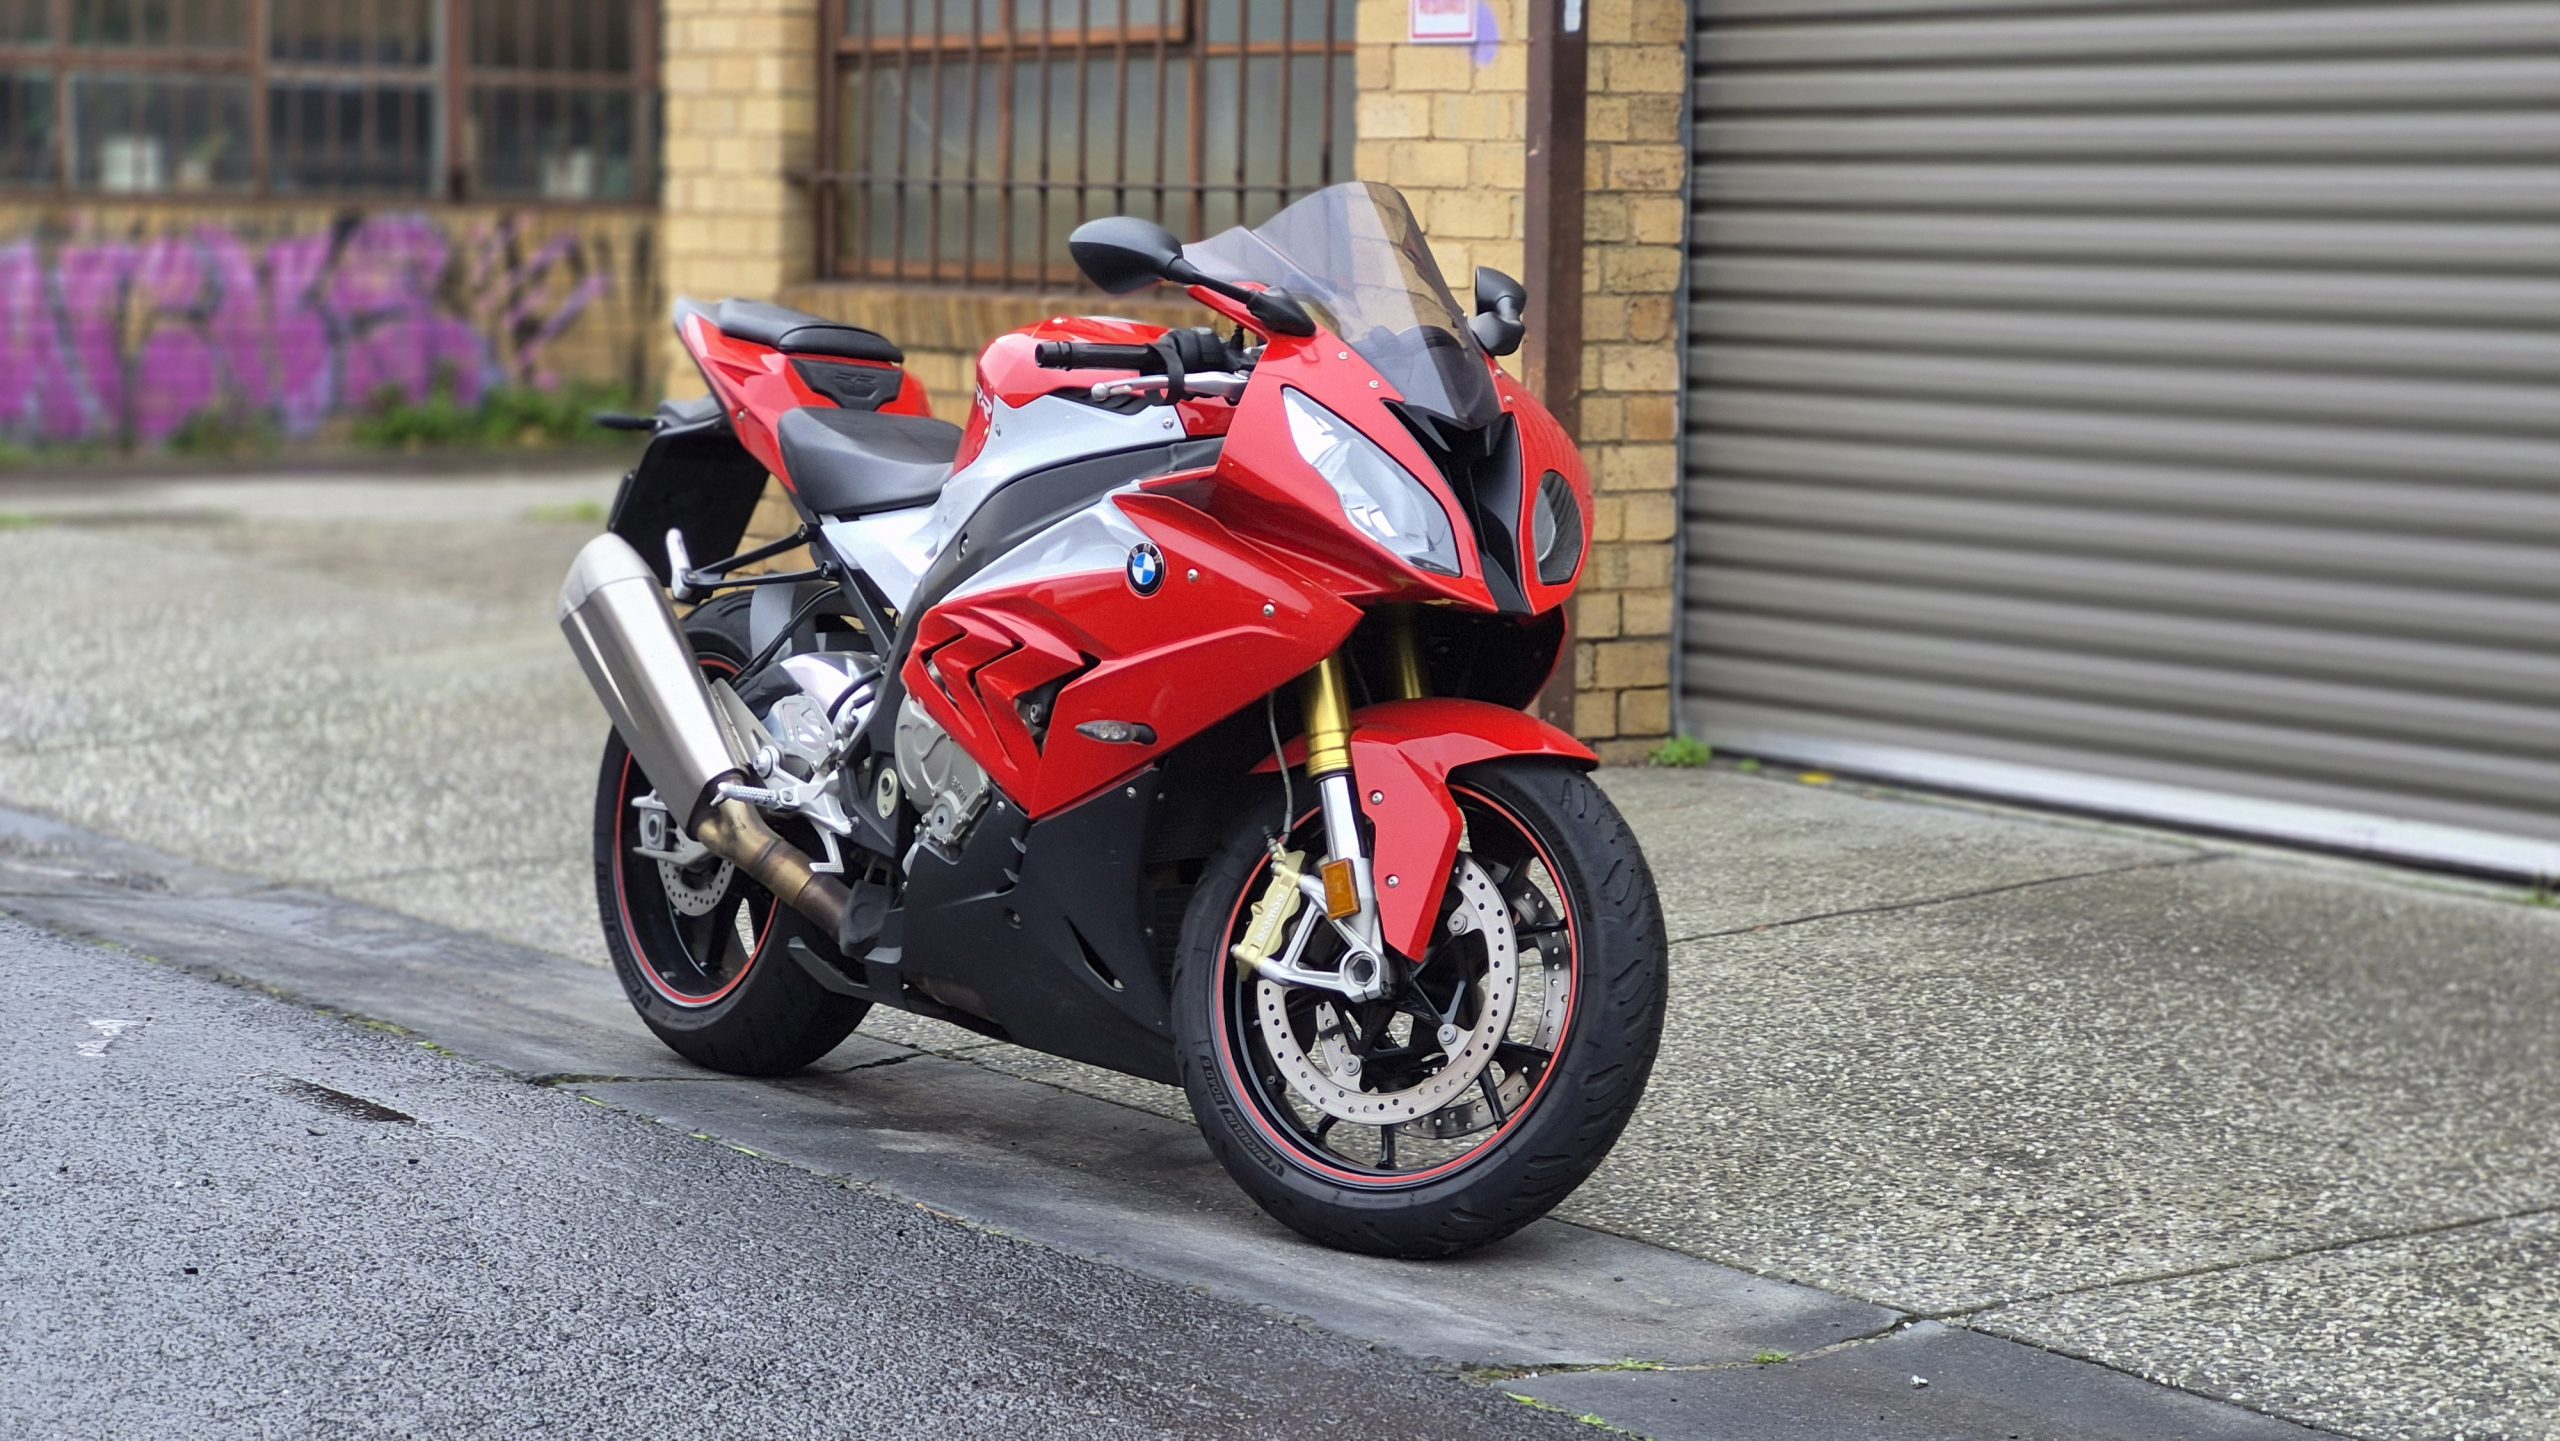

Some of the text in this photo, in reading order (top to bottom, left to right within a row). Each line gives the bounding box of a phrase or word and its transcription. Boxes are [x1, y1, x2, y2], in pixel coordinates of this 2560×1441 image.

[1132, 543, 1162, 564] BMW
[1205, 1071, 1225, 1104] ROAD
[1224, 1112, 1269, 1163] MICHELIN
